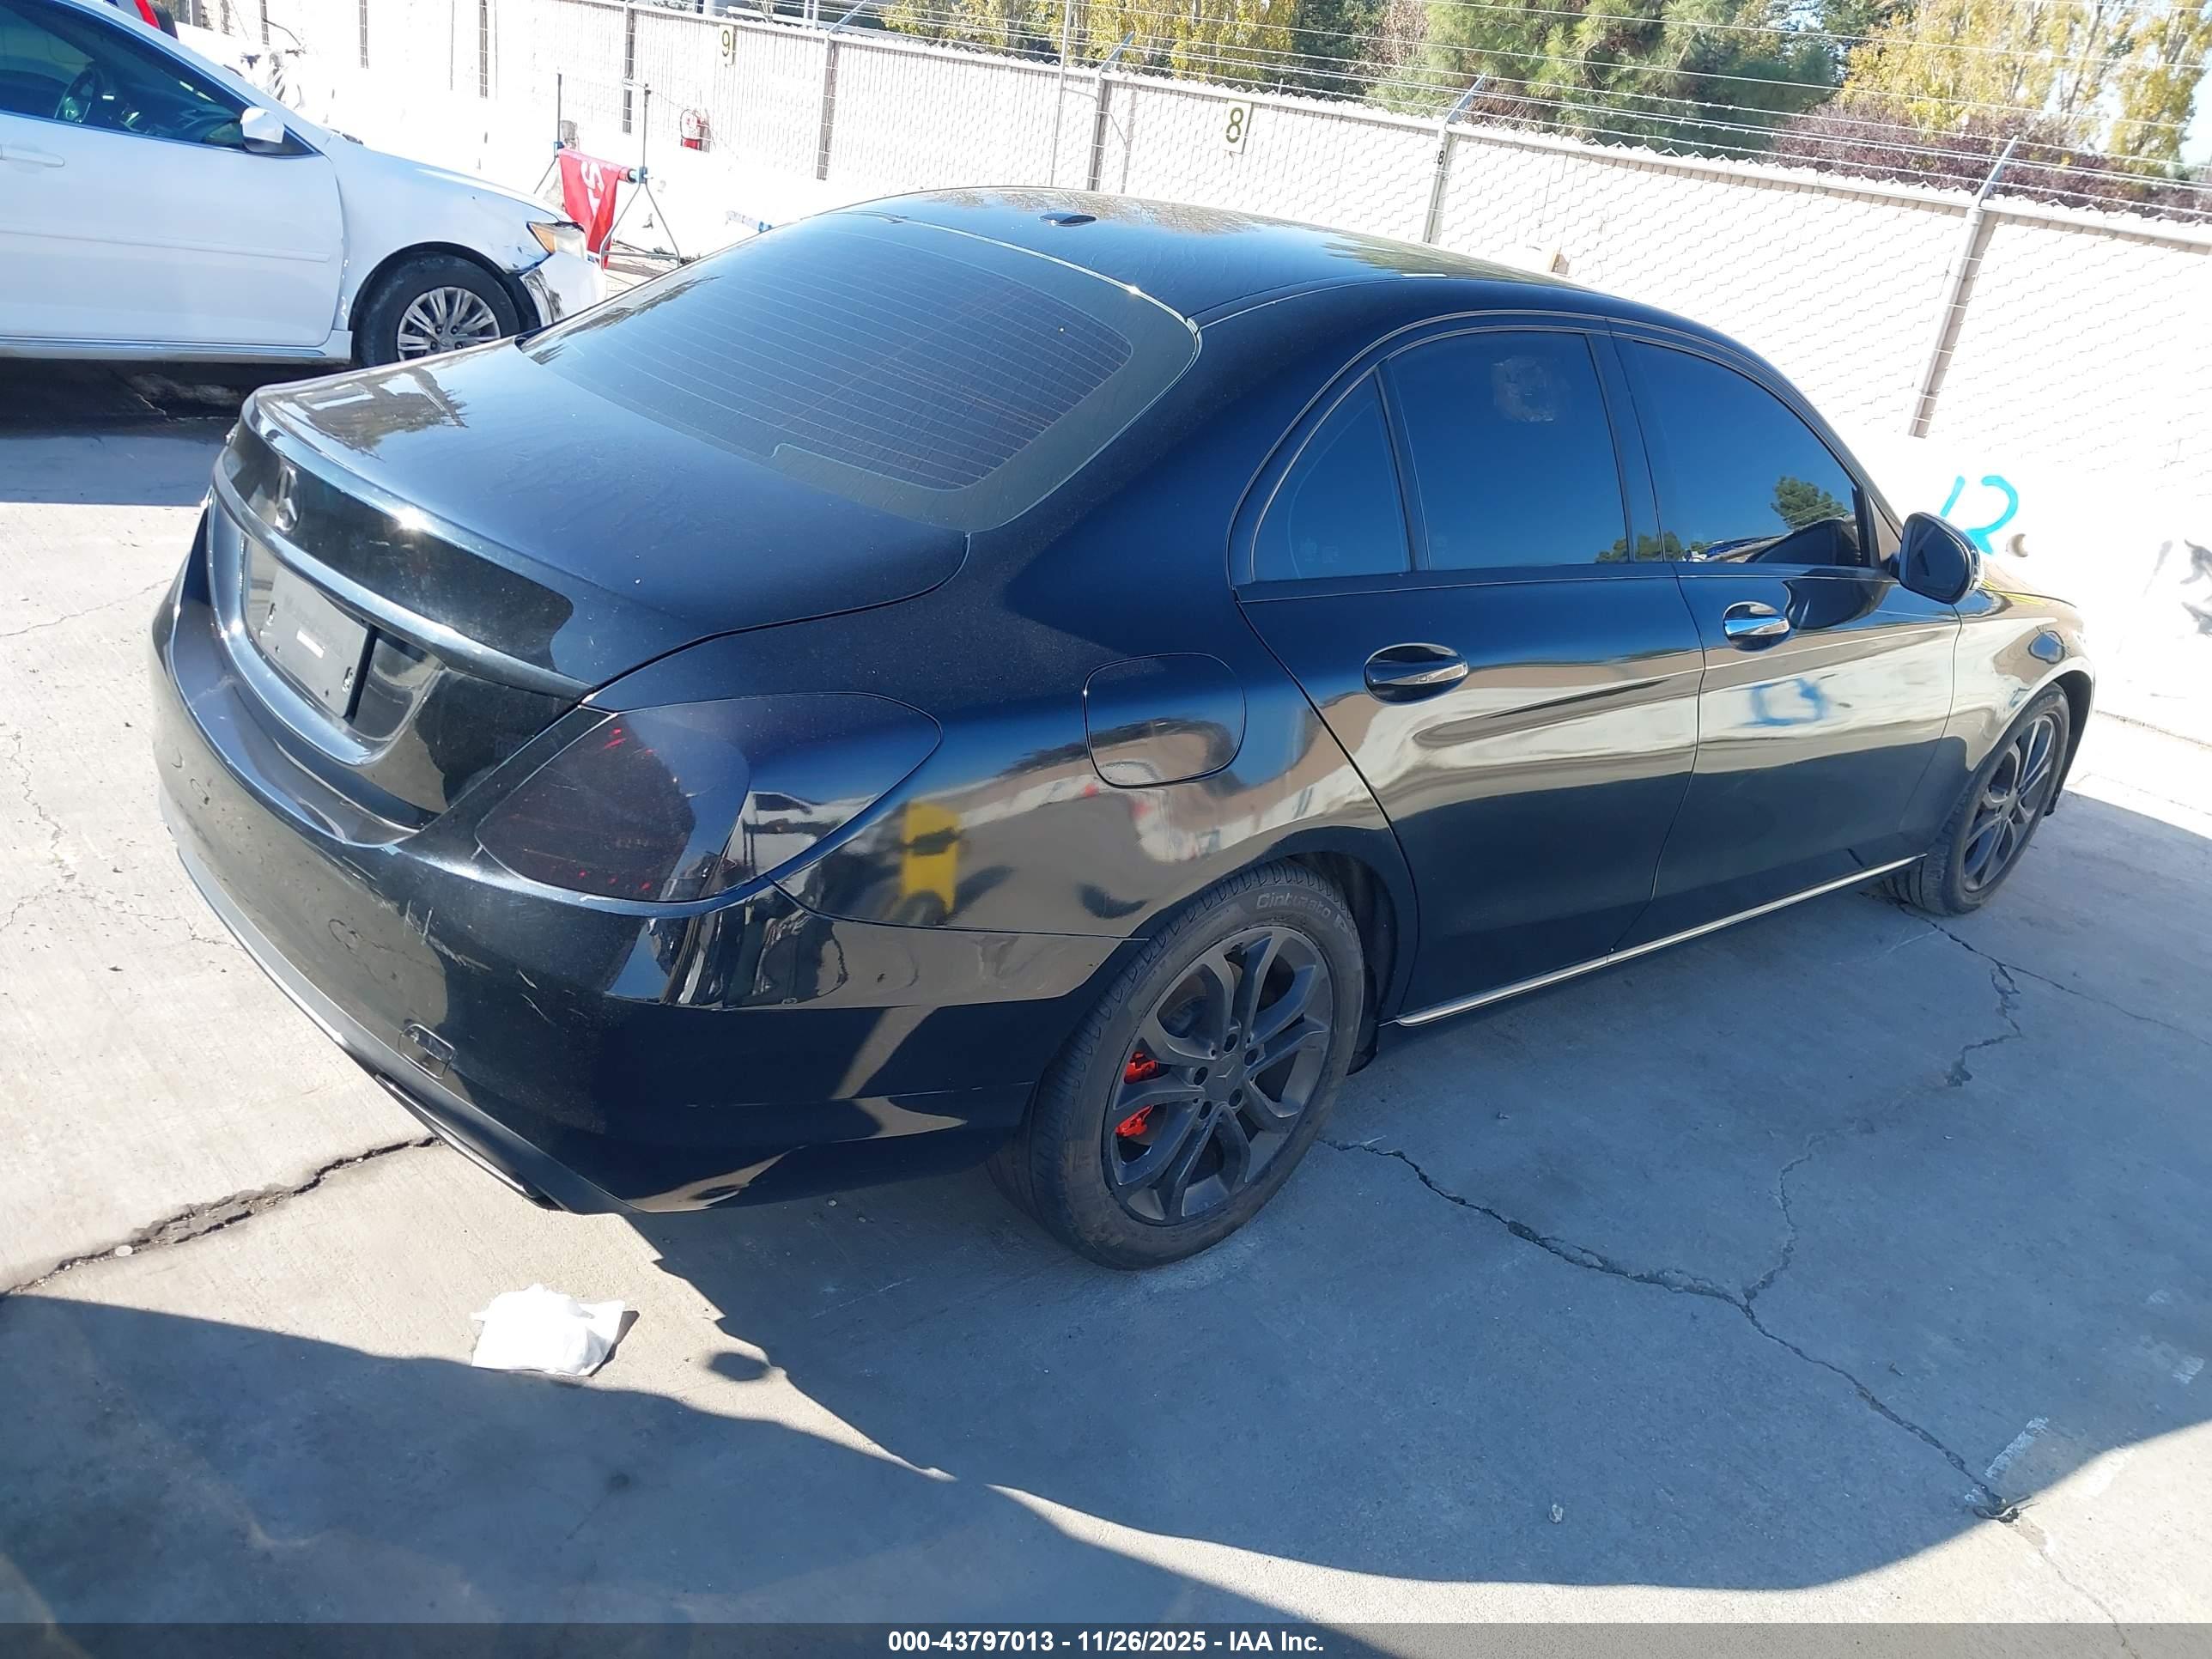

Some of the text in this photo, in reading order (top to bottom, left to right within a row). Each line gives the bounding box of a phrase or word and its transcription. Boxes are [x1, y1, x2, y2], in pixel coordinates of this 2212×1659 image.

[721, 29, 730, 58] 9
[1226, 106, 1244, 143] 8
[1256, 892, 1331, 918] Cinturato
